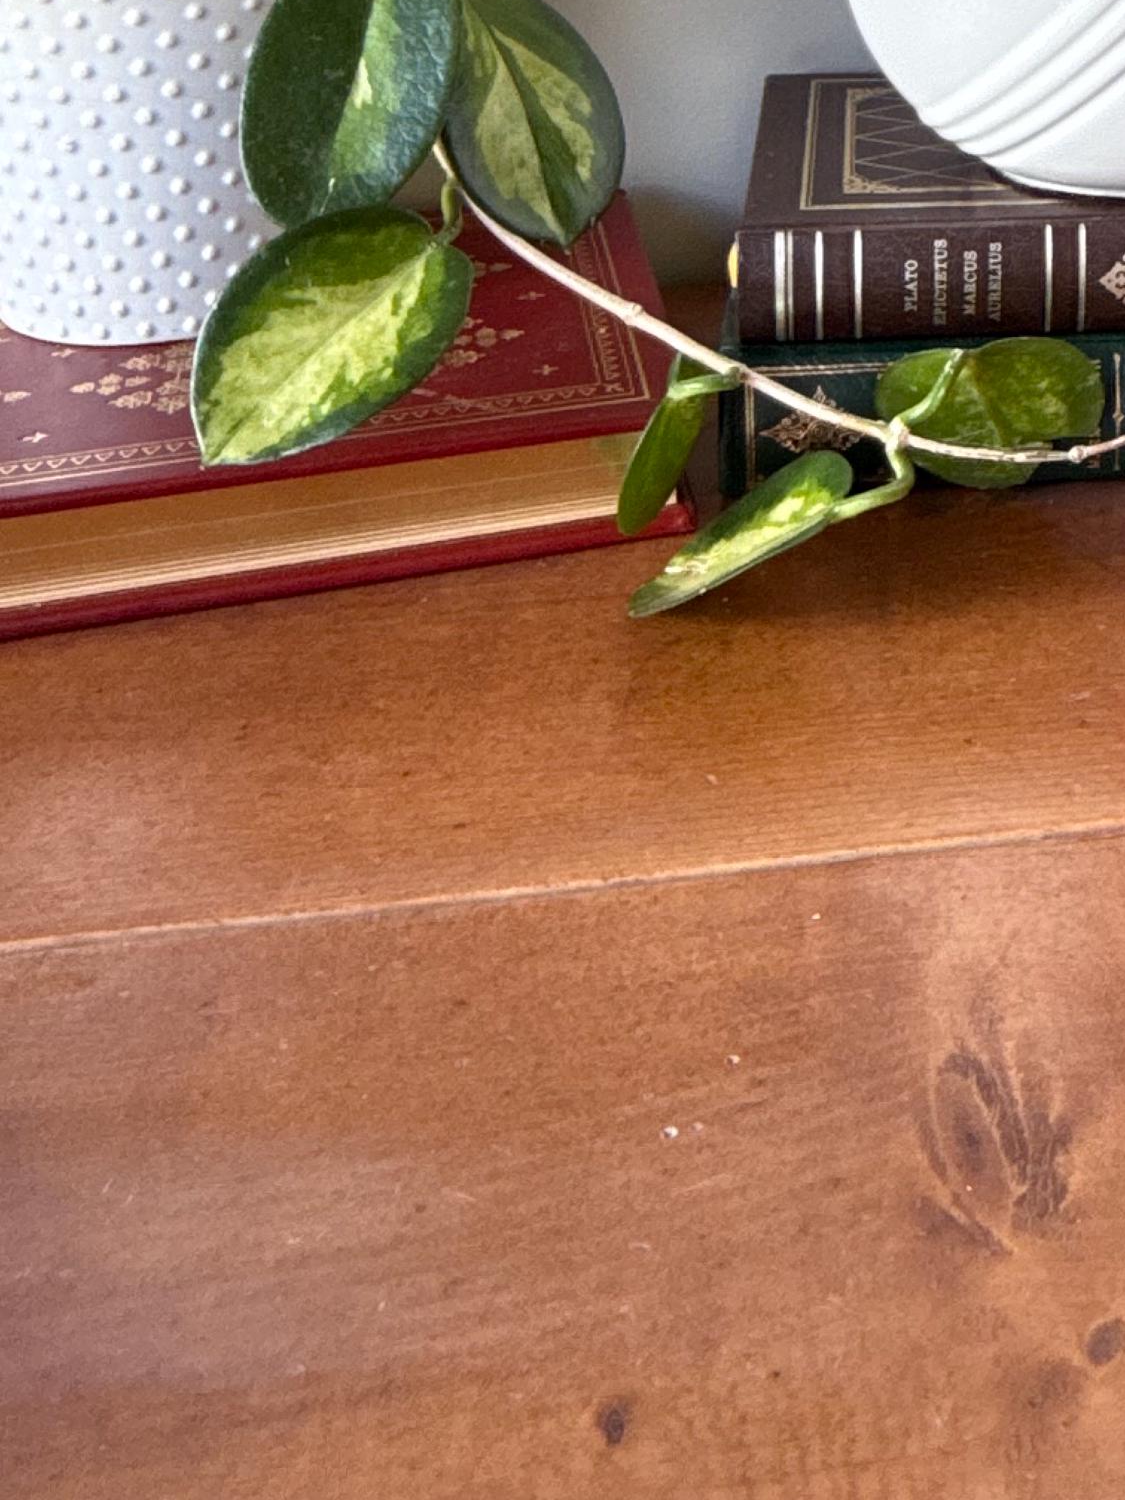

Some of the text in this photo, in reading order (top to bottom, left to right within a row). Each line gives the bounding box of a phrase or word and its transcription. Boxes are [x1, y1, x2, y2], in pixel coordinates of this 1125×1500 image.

[904, 259, 919, 312] PLATO
[933, 238, 948, 326] EPICTETUS
[963, 250, 978, 316] MARCUS
[988, 241, 1003, 322] AURELIUS
